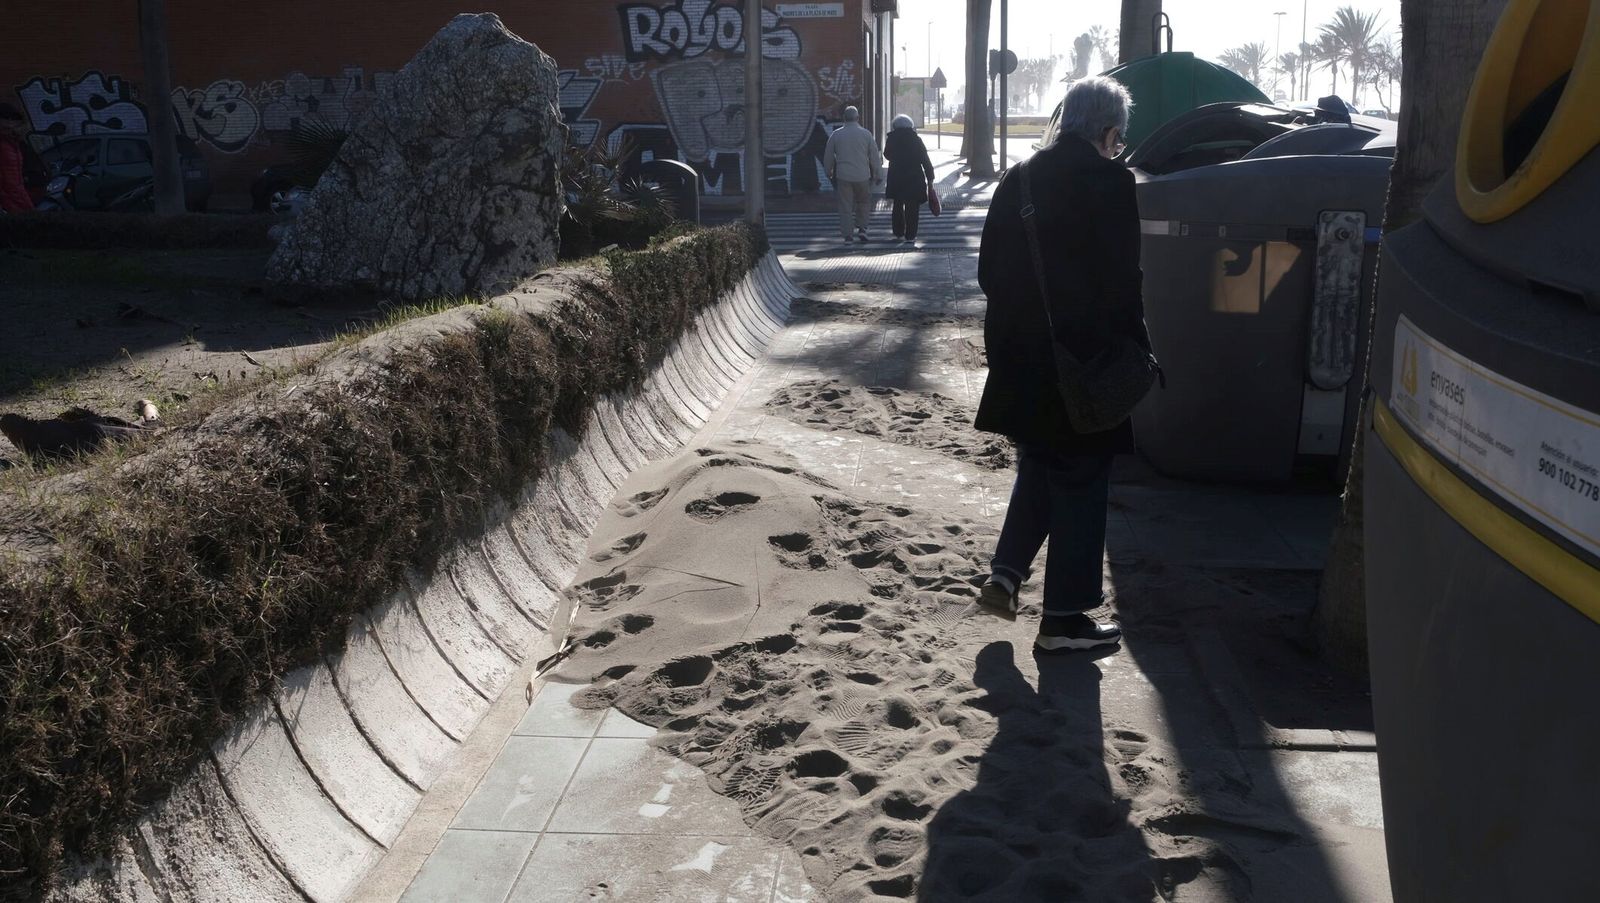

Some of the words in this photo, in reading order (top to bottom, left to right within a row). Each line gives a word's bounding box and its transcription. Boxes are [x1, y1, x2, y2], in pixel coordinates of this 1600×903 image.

[1538, 457, 1556, 479] 900
[1559, 468, 1577, 490] 102
[1578, 478, 1600, 501] 778
